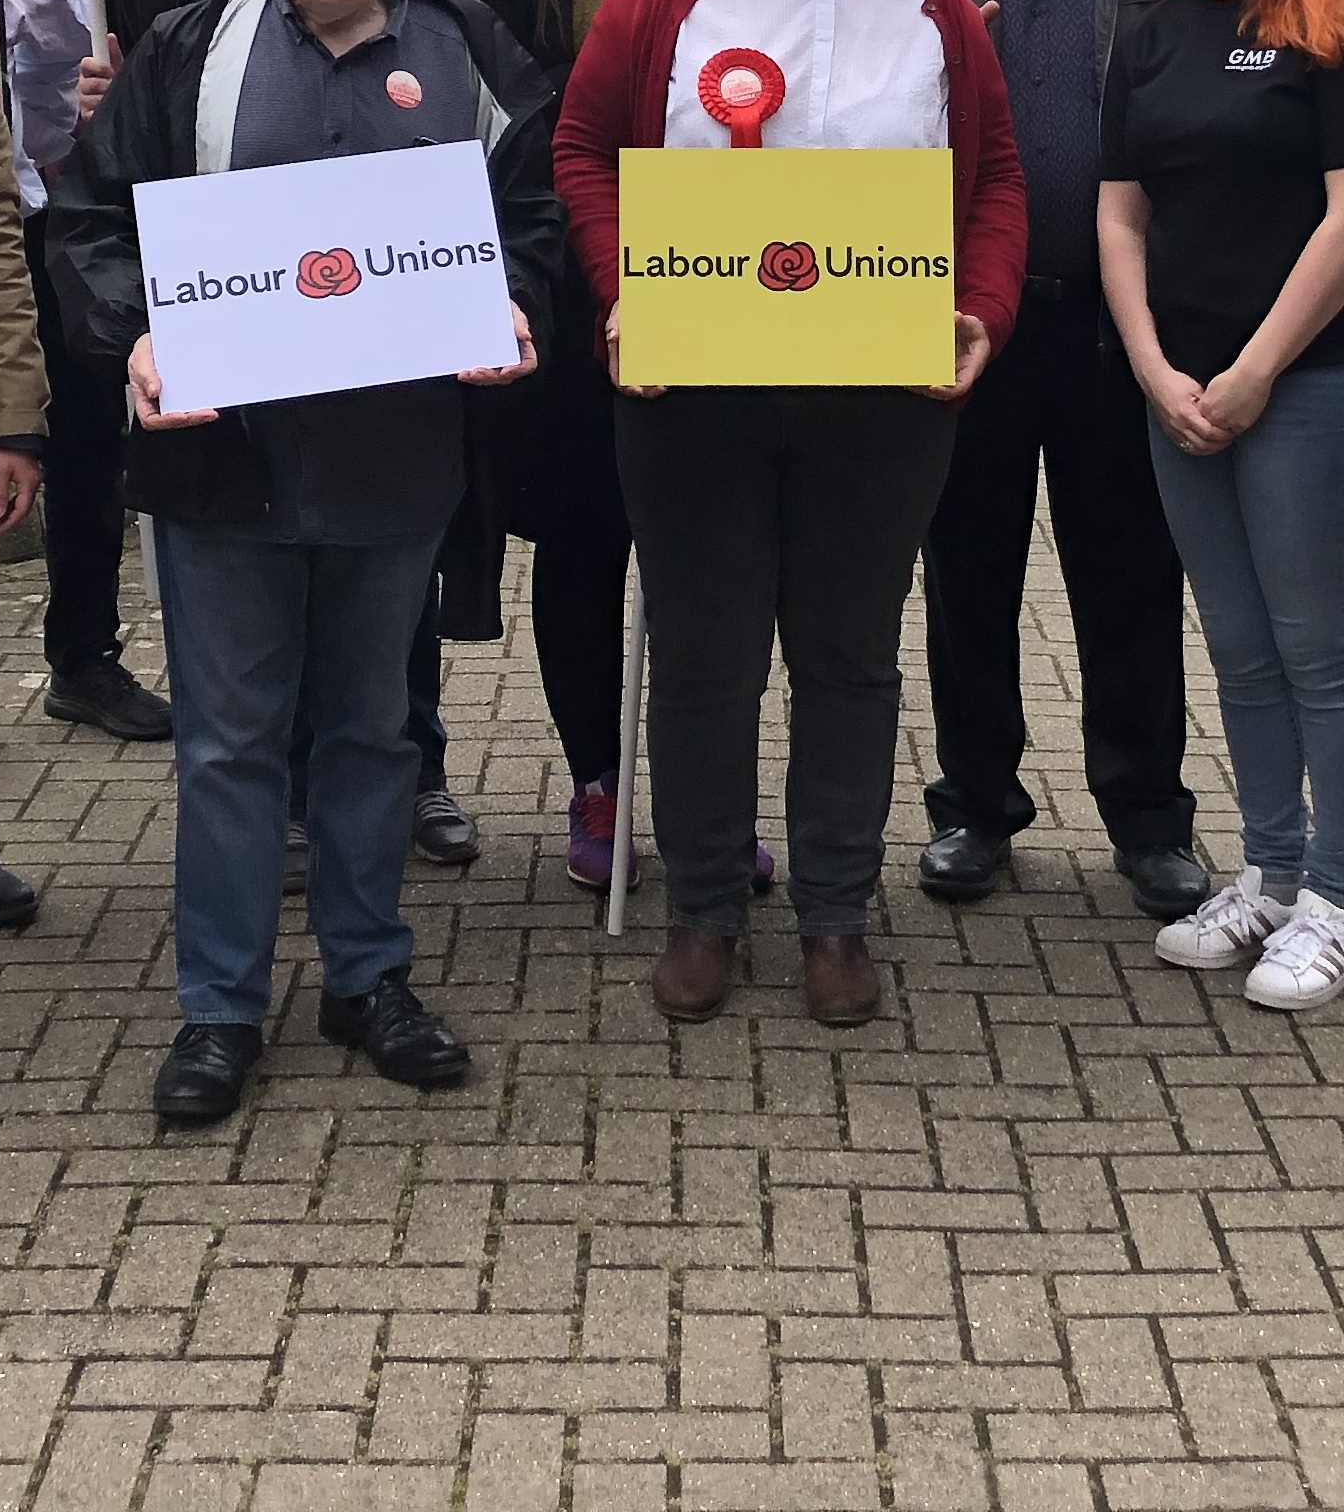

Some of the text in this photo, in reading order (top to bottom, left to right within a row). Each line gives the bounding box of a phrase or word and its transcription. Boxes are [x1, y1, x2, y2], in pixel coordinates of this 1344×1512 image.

[1229, 48, 1276, 65] GMB
[150, 240, 497, 308] Labour Unions
[623, 245, 950, 278] Labour Unions
